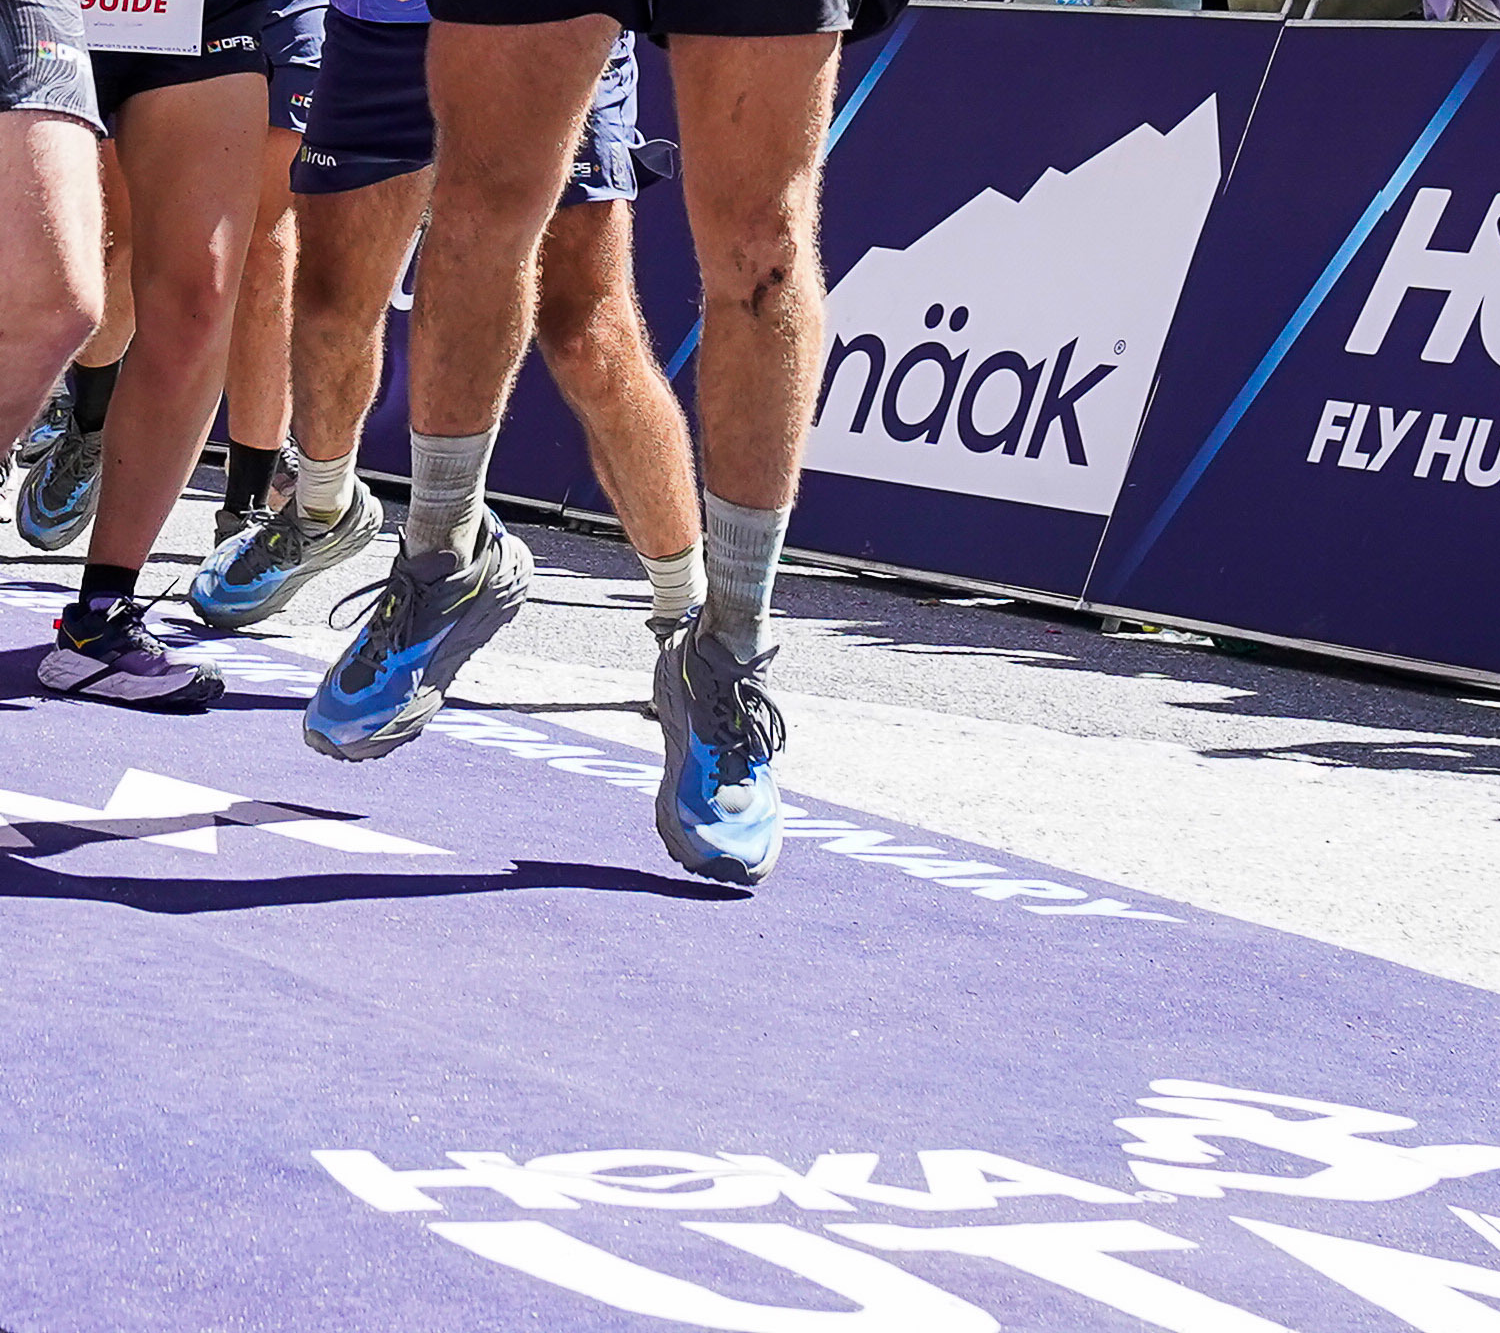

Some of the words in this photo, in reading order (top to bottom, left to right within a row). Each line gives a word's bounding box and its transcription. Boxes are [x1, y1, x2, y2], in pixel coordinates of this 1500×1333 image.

[819, 301, 1118, 469] näak
[1307, 399, 1424, 472] FLY
[310, 1147, 1149, 1212] HOKA
